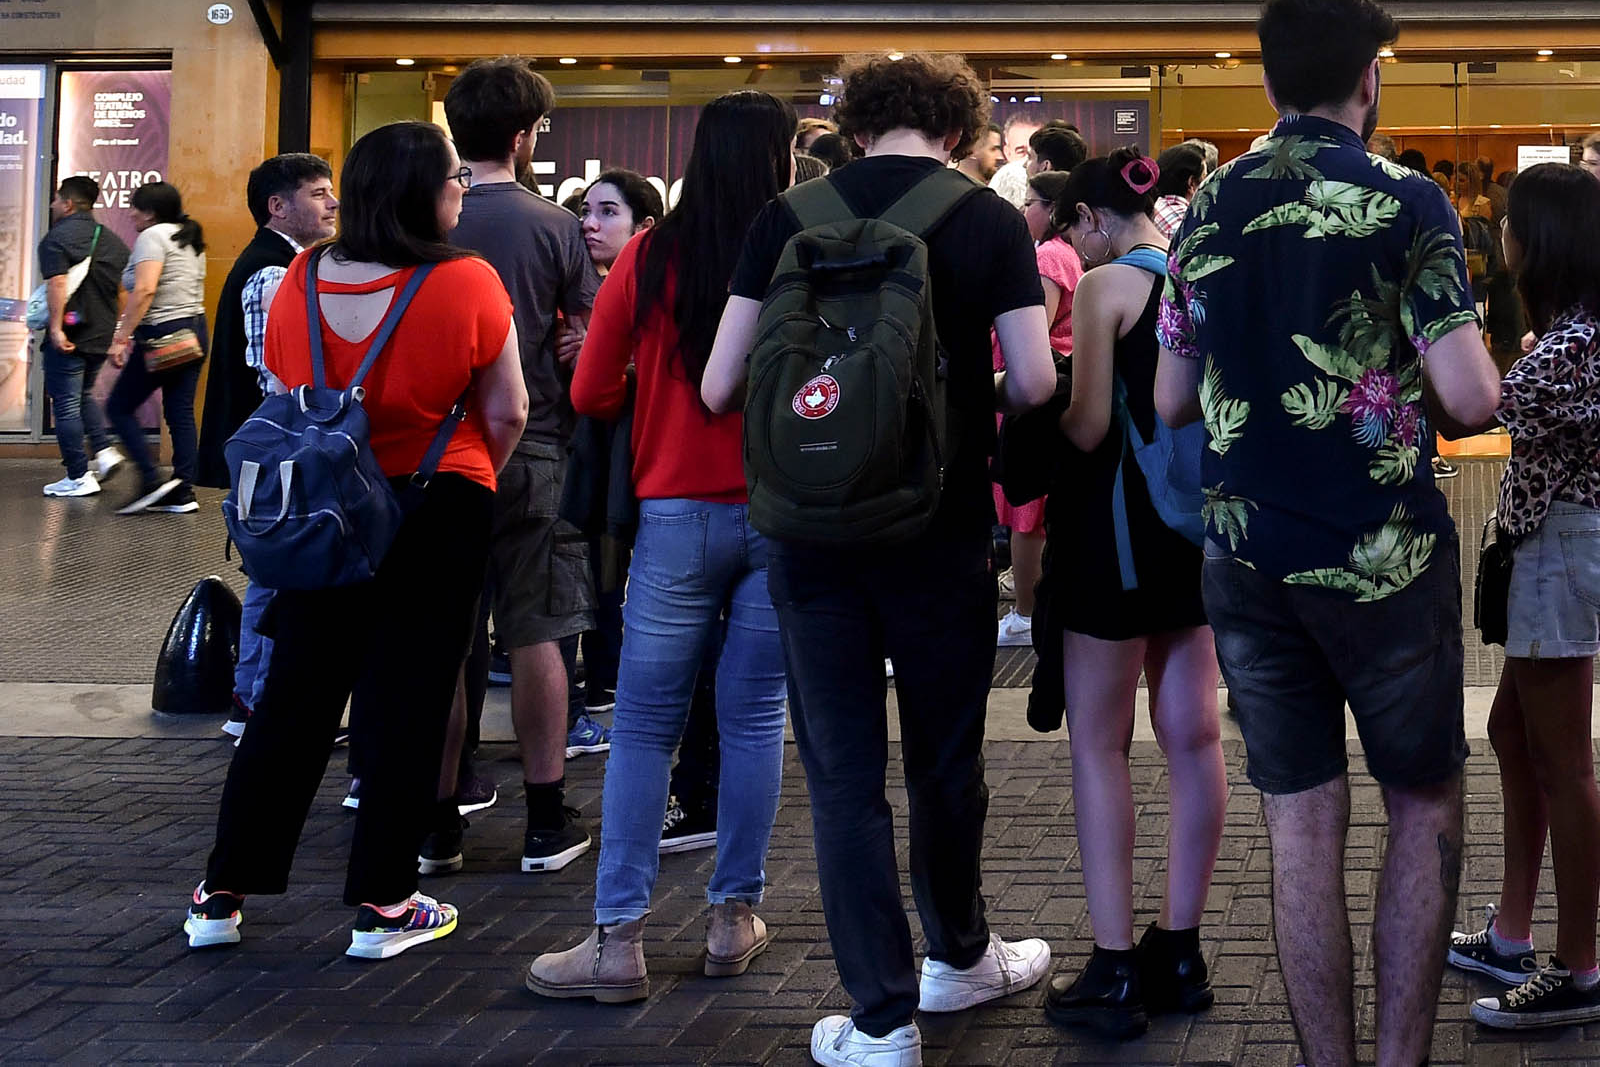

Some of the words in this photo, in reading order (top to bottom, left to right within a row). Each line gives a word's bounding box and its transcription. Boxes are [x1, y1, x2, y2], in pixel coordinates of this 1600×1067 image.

[211, 9, 230, 20] 1659
[0, 77, 26, 85] udad
[94, 93, 144, 102] COMPLEJO
[94, 102, 135, 110] TEATRAL
[94, 110, 107, 119] DE
[108, 110, 146, 119] BUENOS
[0, 113, 17, 127] do
